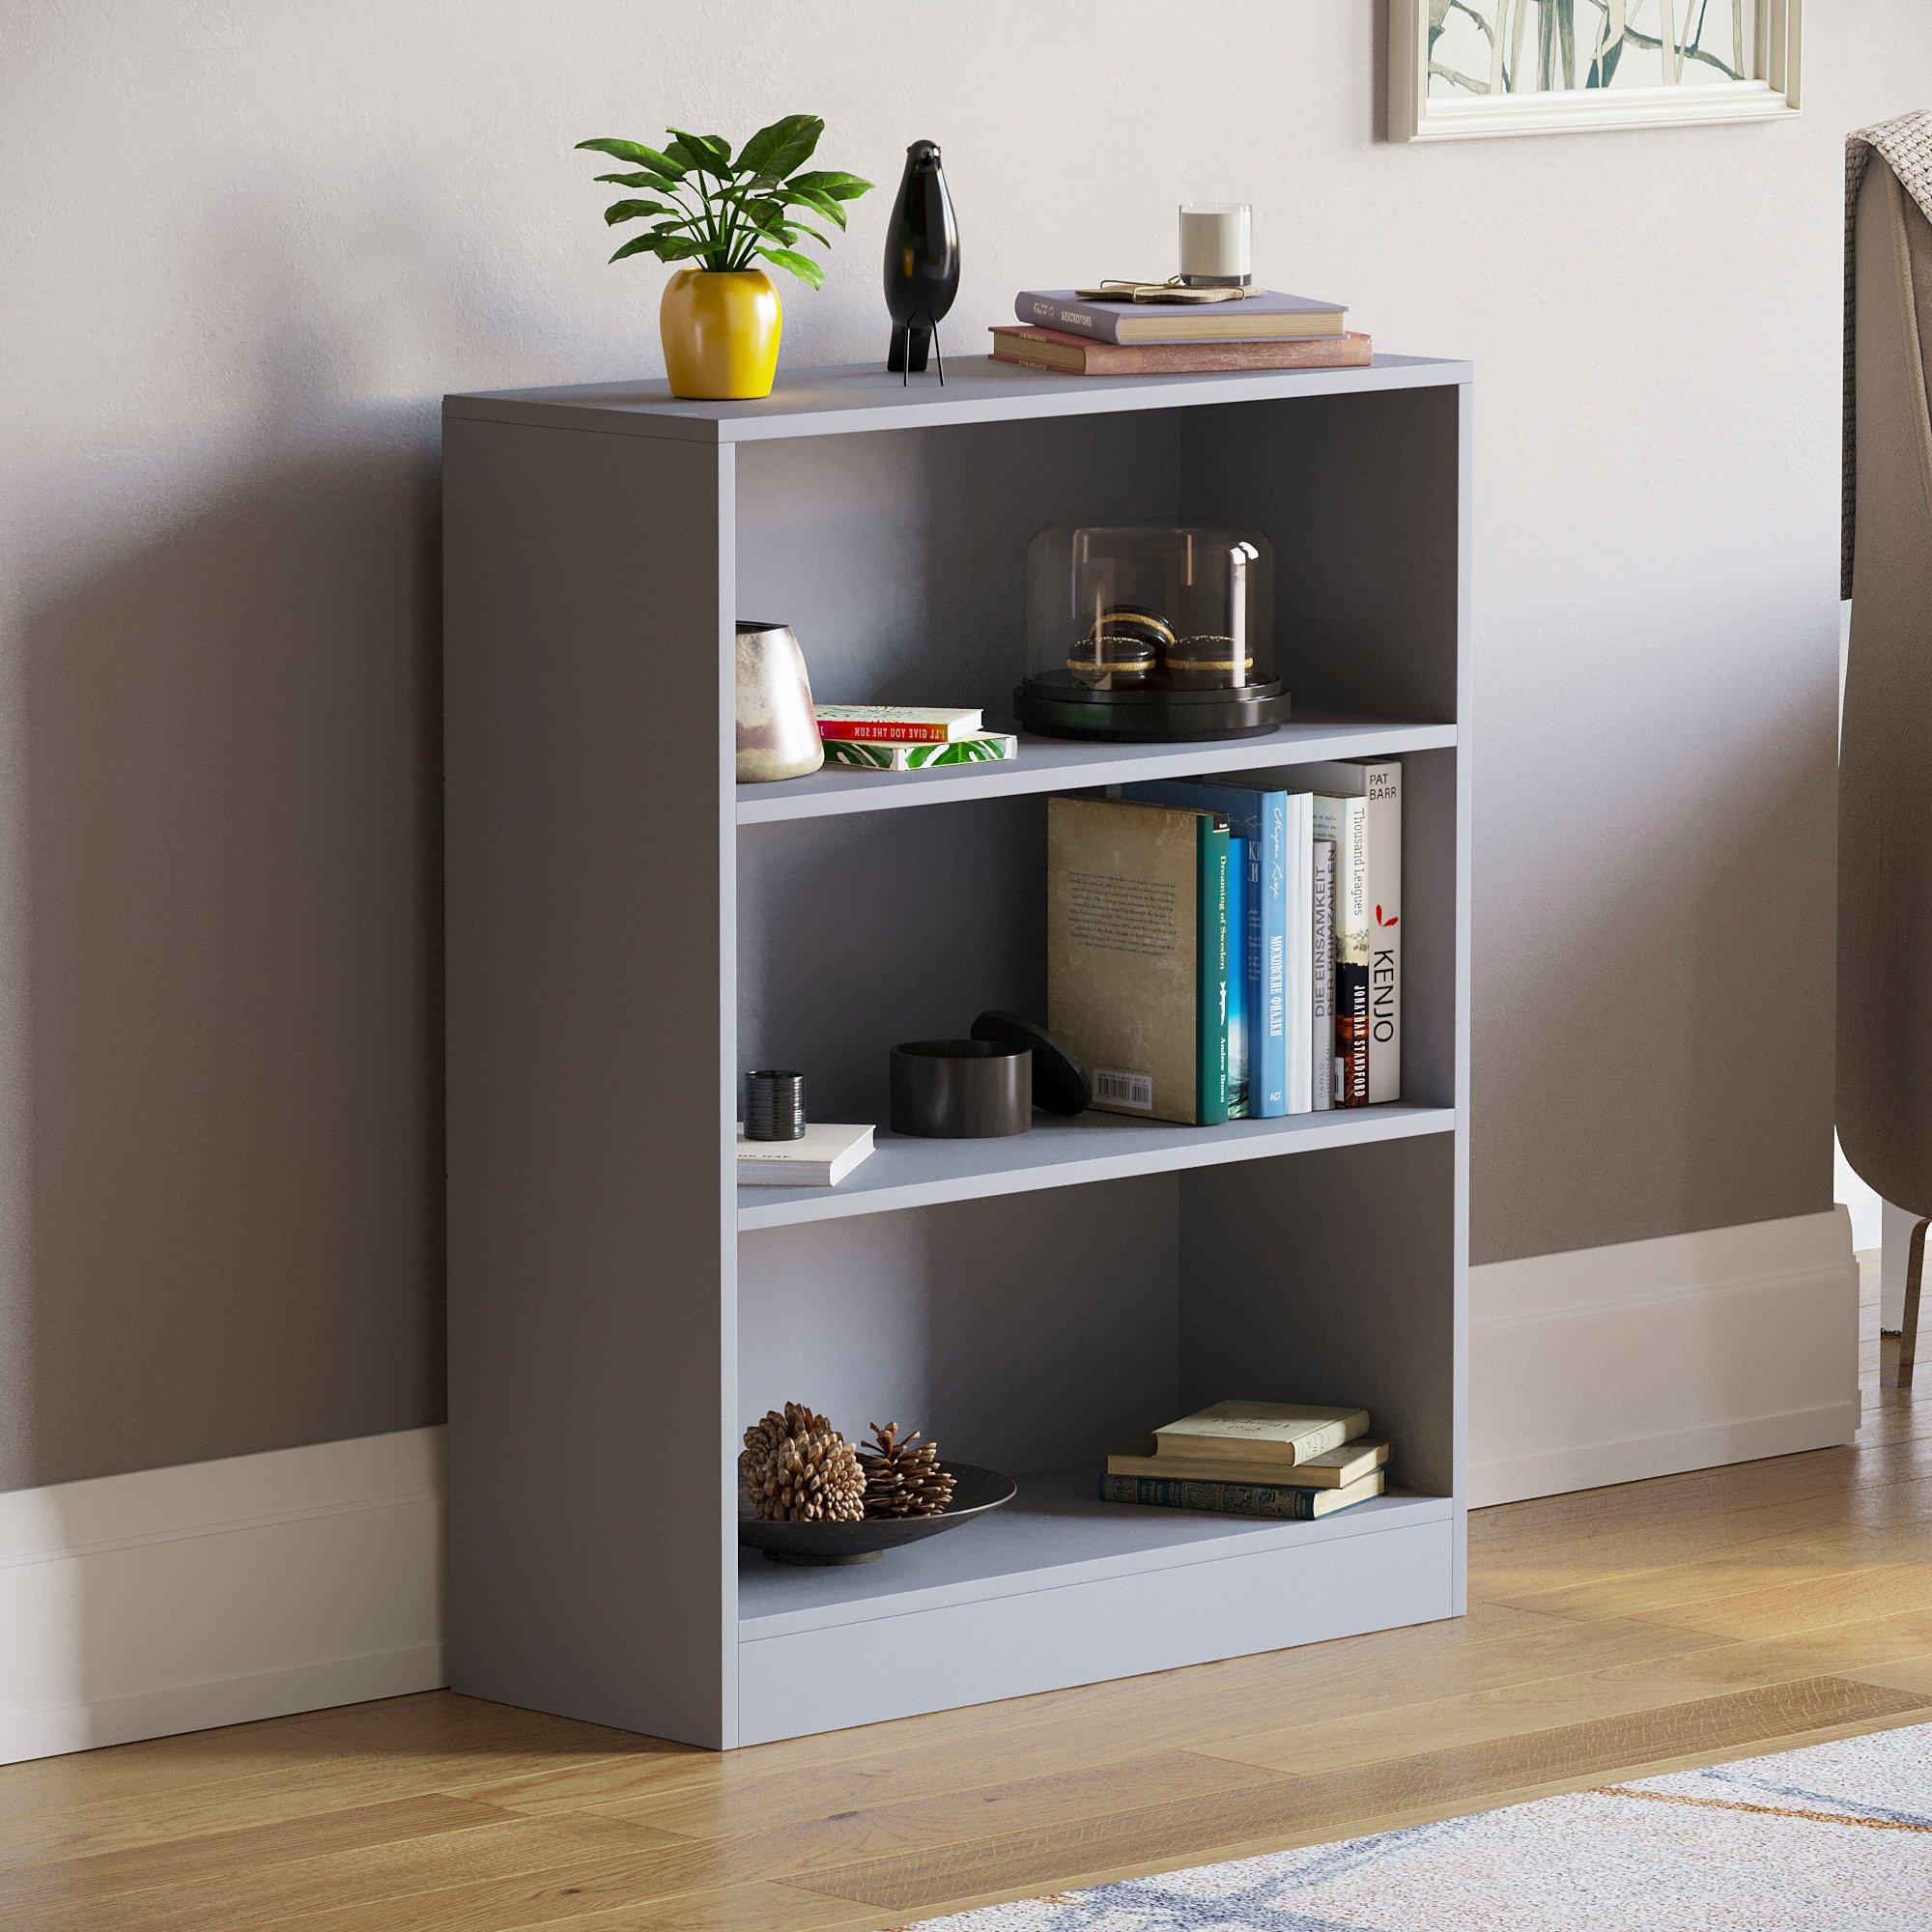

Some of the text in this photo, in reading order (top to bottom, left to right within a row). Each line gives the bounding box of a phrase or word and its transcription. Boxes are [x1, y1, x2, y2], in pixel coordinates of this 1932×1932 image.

[1370, 773, 1388, 785] PAT
[1370, 787, 1397, 801] BARR
[1350, 808, 1365, 916] Thousand Leagues
[1220, 912, 1227, 924] of
[1315, 867, 1325, 1017] DIE EINSAMKEIT
[1353, 985, 1366, 1097] JONATHAN STANDFORD
[1374, 950, 1394, 1042] KENJO
